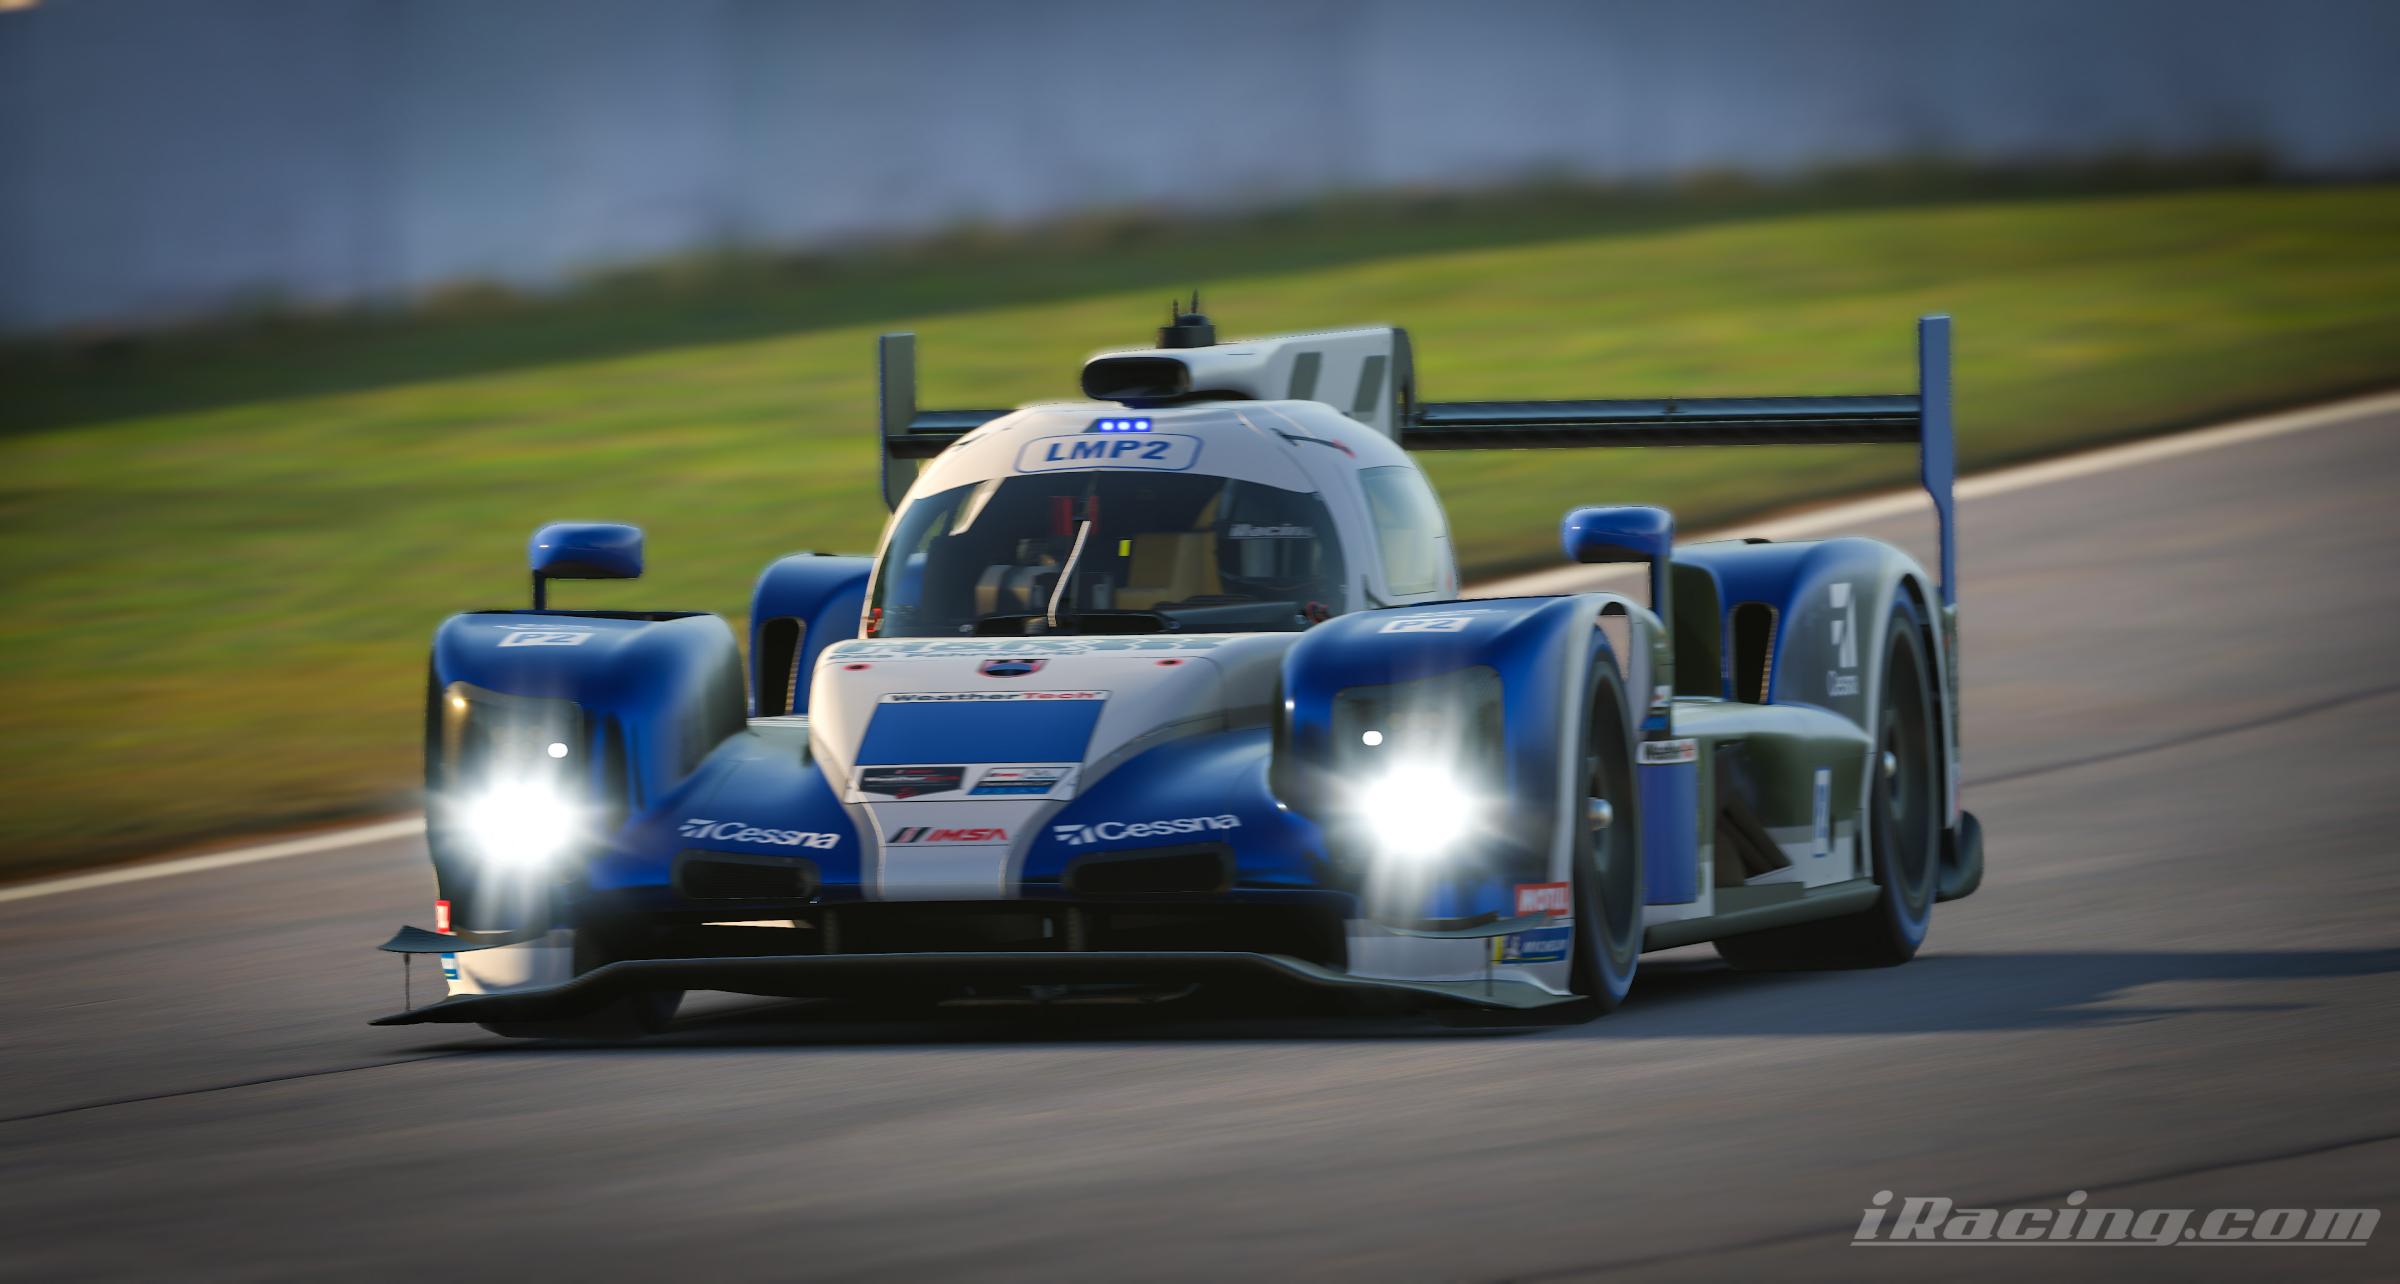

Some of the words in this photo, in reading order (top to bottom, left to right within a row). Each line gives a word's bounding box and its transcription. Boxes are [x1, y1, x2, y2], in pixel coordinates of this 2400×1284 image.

[1045, 440, 1171, 462] LMP2
[892, 691, 1095, 702] WeatherTech
[711, 821, 842, 849] Cessna
[1094, 814, 1242, 840] Cessna
